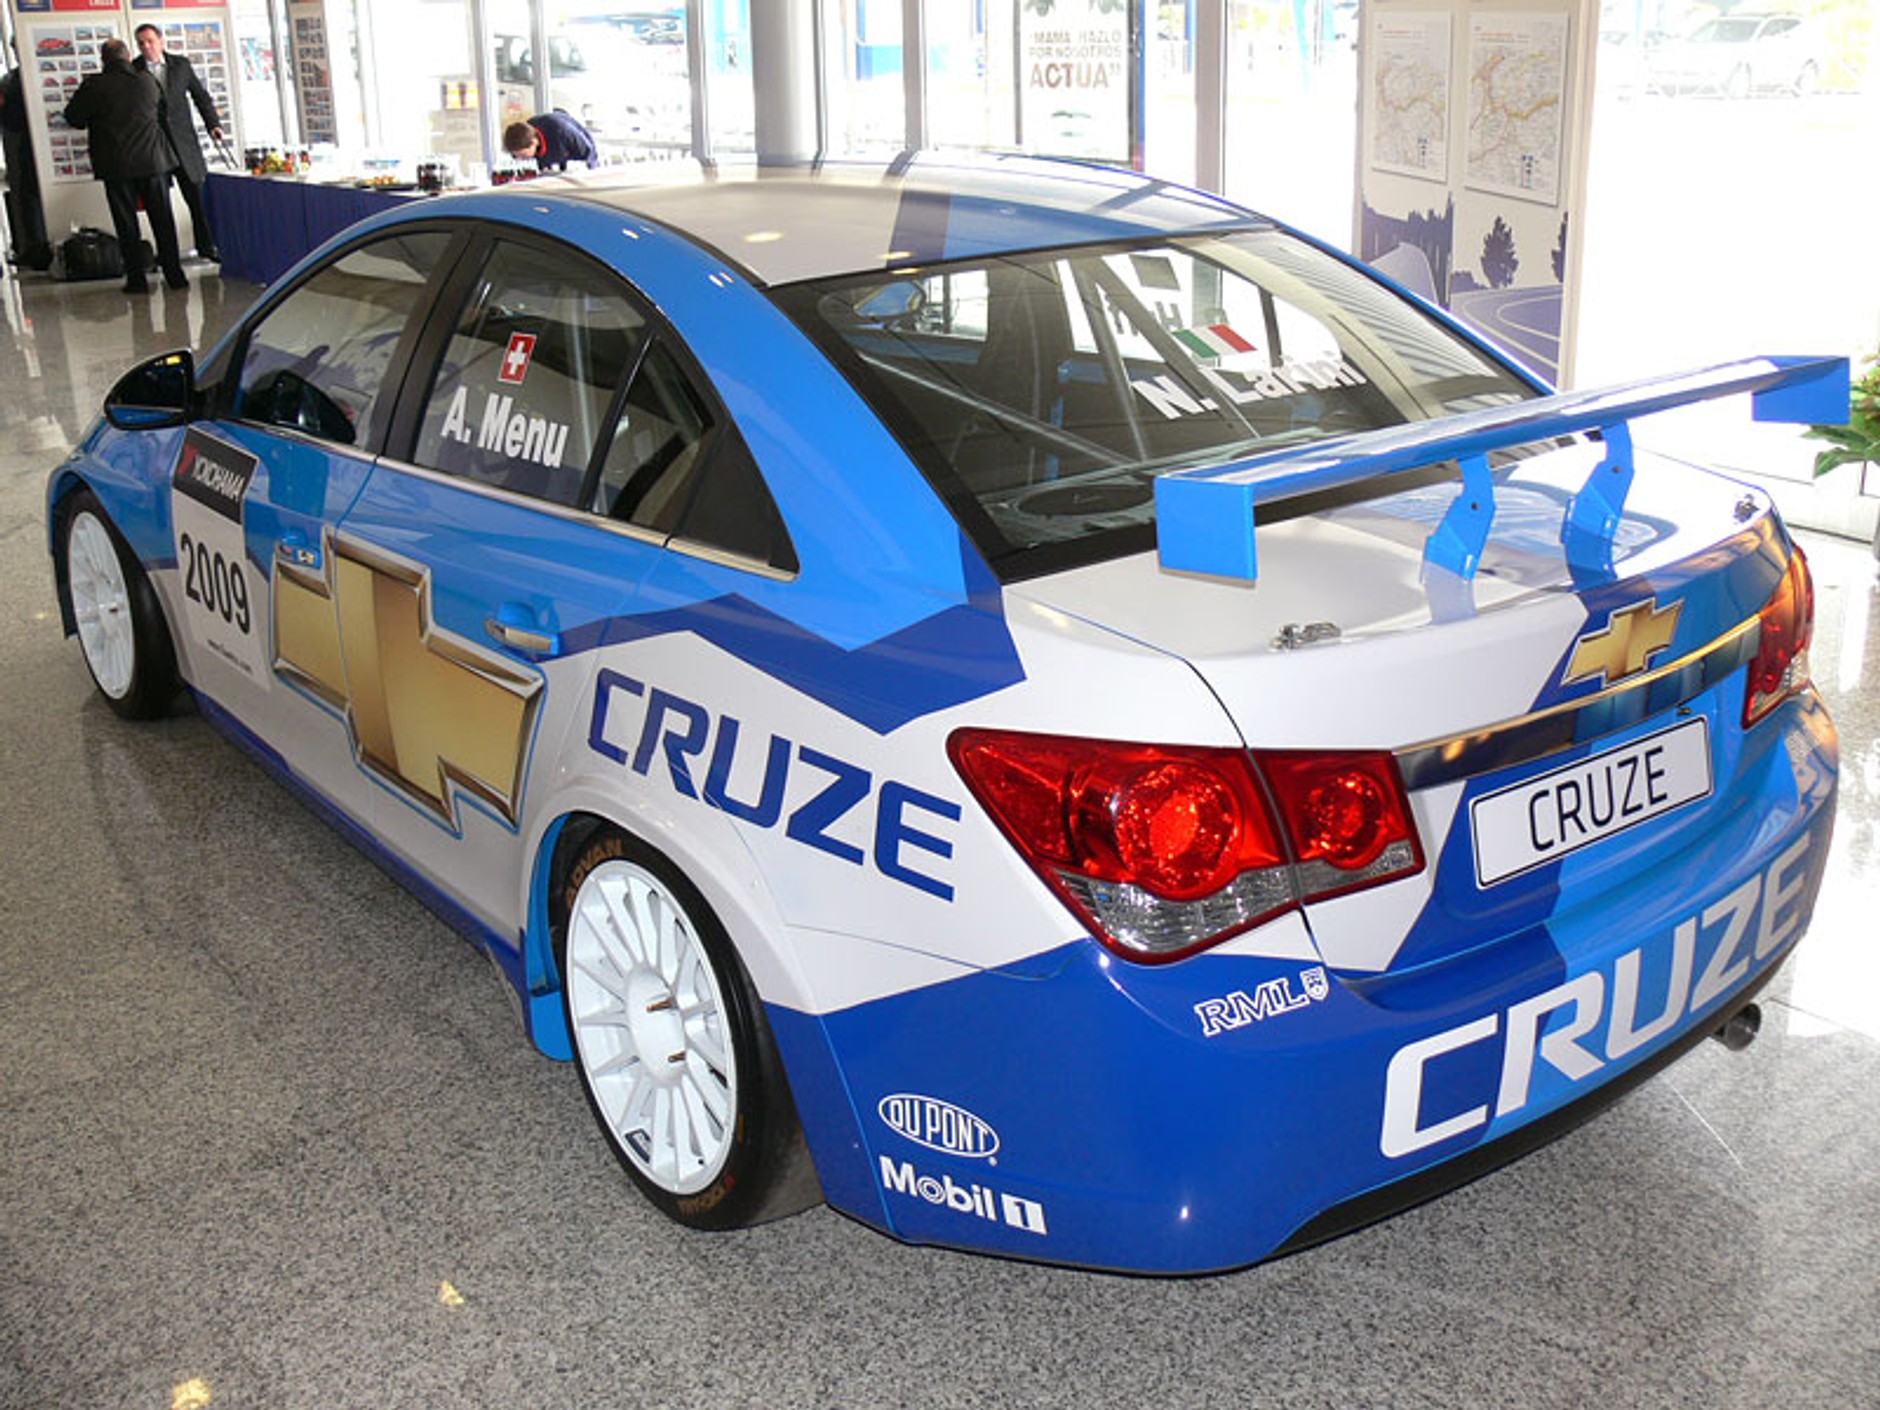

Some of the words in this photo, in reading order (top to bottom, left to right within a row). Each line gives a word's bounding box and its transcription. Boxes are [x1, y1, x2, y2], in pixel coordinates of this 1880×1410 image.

[441, 384, 471, 443] A.
[477, 392, 569, 468] Menu
[1131, 375, 1219, 420] N.
[180, 532, 250, 635] 2009
[587, 667, 963, 903] CRUZE
[1527, 744, 1669, 853] CRUZE
[1193, 977, 1310, 1038] RML
[1379, 836, 1812, 1159] CRUZE
[879, 1154, 998, 1221] Mobil
